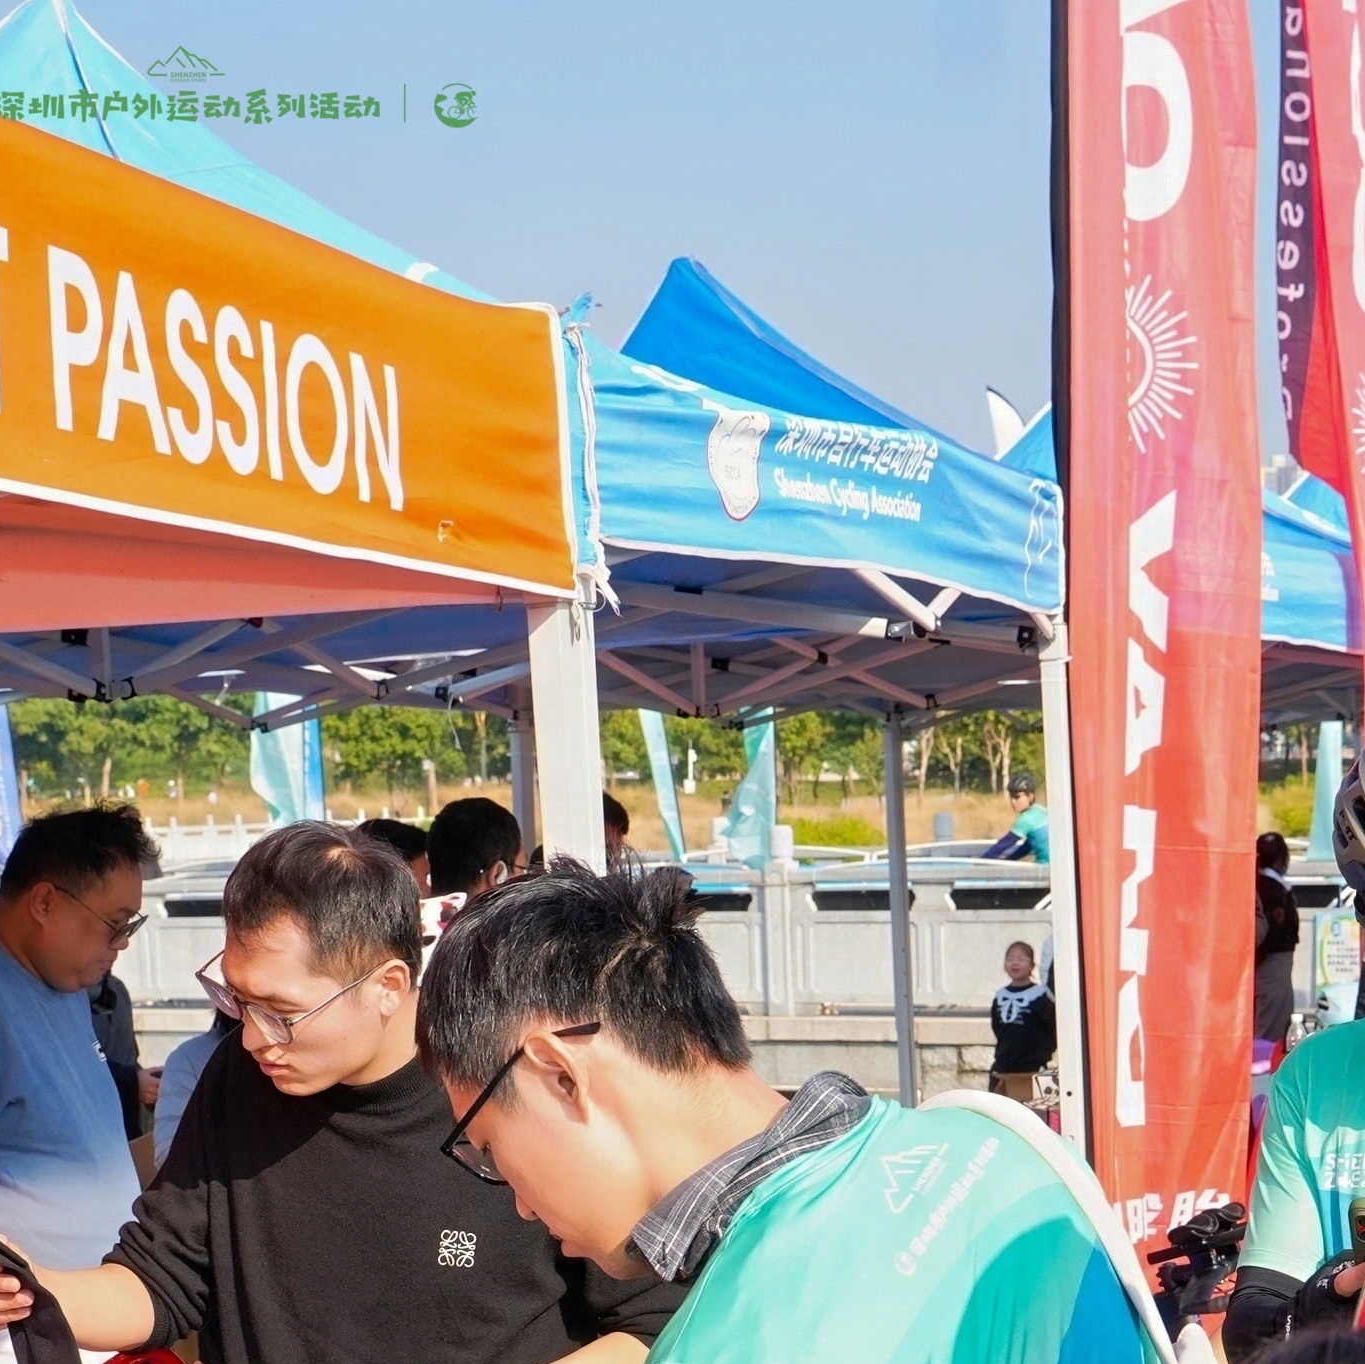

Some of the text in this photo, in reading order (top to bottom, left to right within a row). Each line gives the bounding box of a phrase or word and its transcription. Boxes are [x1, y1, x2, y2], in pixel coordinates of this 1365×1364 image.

[46, 244, 404, 512] PASSION
[773, 466, 923, 522] Shenzhen Cycling Association
